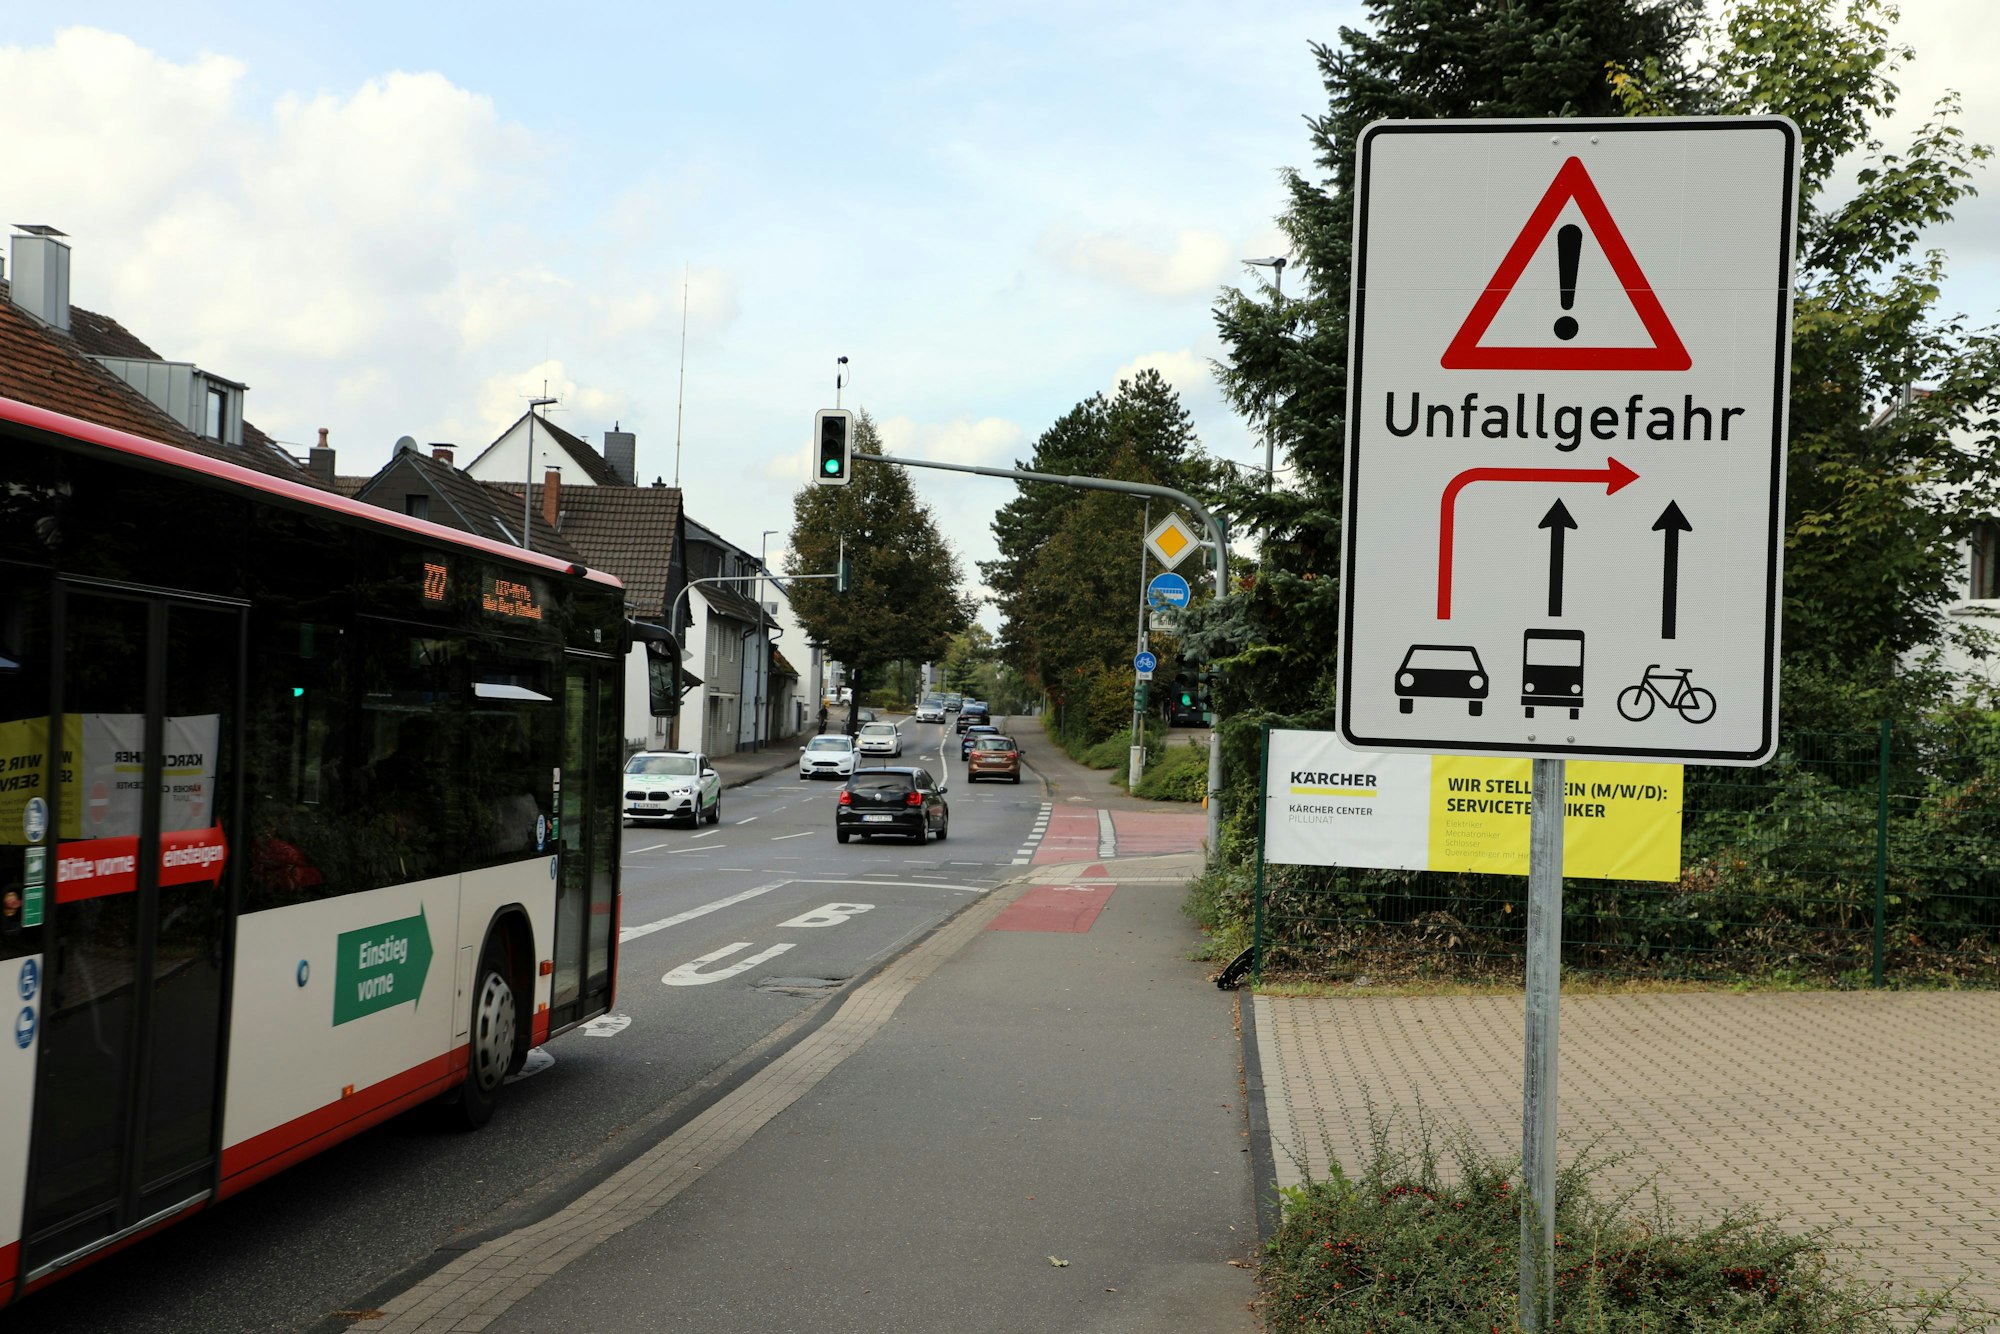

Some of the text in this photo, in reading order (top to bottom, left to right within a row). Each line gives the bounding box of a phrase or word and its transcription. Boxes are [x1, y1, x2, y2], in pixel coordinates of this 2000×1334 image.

[1385, 391, 1746, 452] Unfallgefahr
[1290, 771, 1377, 787] KÄRCHER
[1448, 777, 1481, 792] WIR
[1486, 779, 1532, 795] STELL
[1591, 783, 1667, 802] (M/W/D):
[1289, 804, 1373, 816] KÄRCHER CENTER
[1288, 814, 1334, 825] PILLUNAT
[1446, 819, 1483, 829] Elektriker
[1446, 829, 1501, 839] Mechatroniker
[1445, 839, 1481, 848] Schlosser
[57, 841, 225, 882] Bitte vorne einsteigen
[358, 934, 408, 970] Einstieg
[357, 972, 394, 1002] vorne
